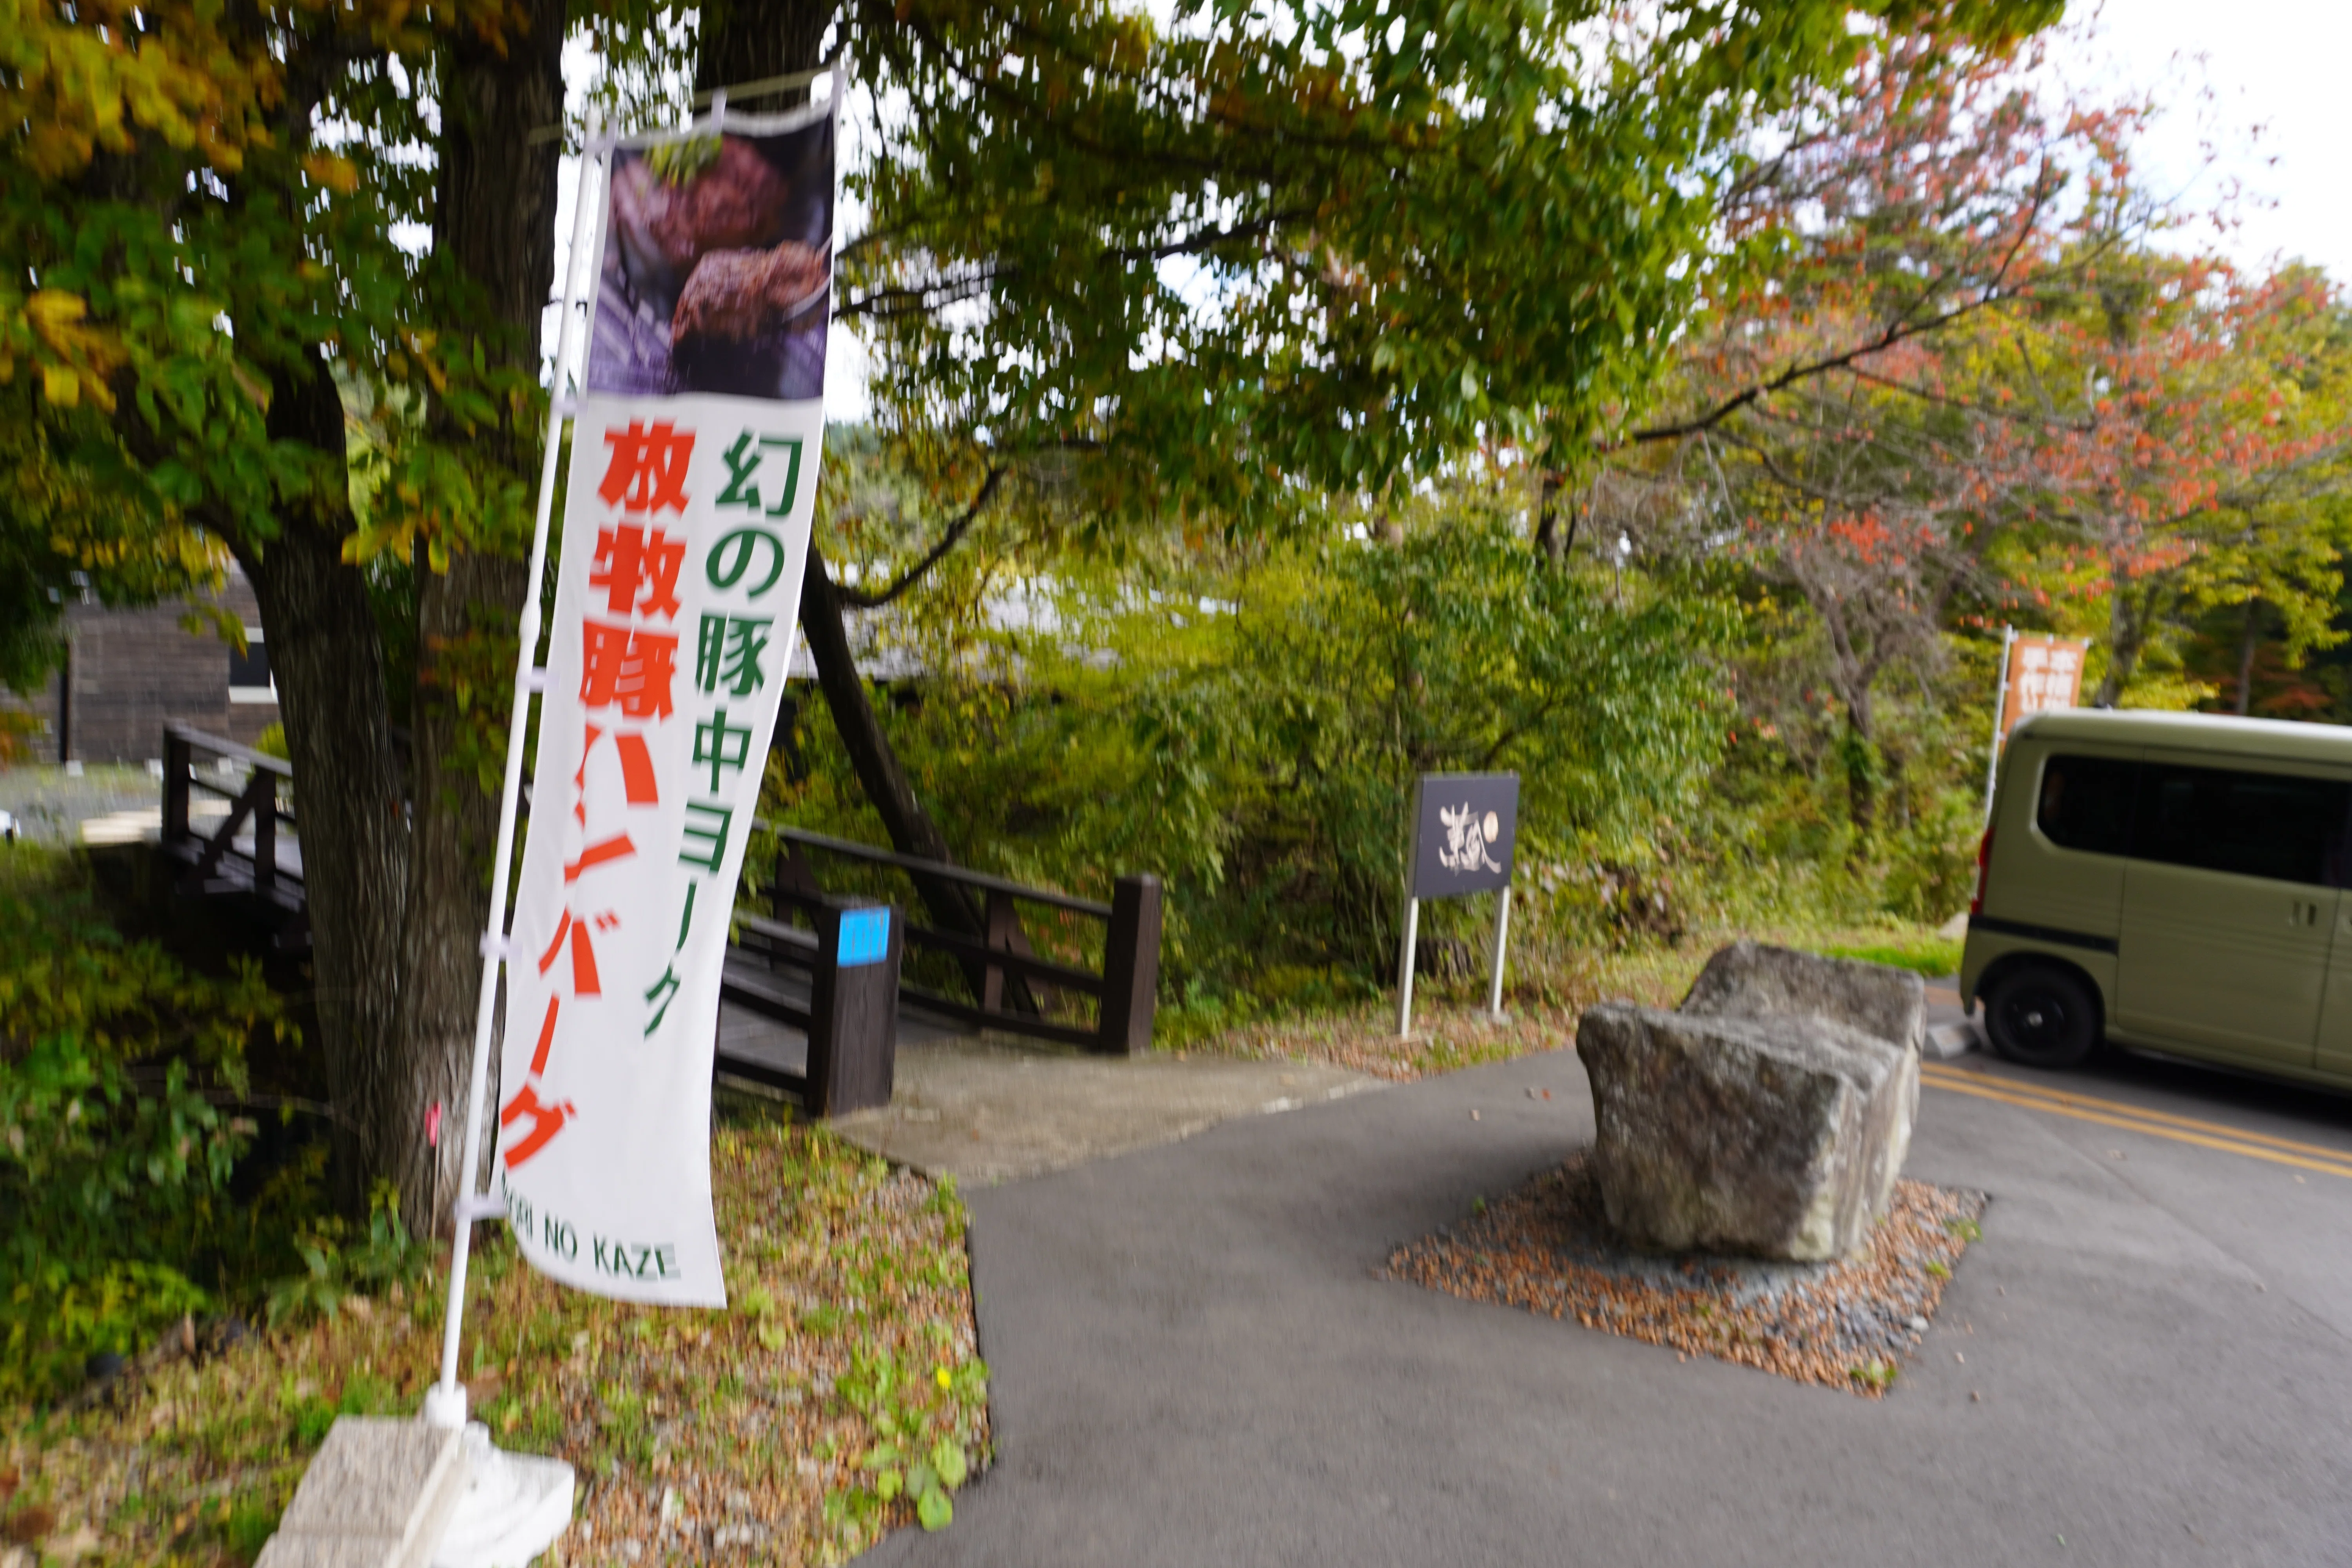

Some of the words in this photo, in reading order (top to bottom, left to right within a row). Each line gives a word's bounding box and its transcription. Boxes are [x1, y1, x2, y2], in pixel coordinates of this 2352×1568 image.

[500, 417, 696, 1170] 放牧豚ハンバーグ
[545, 1211, 577, 1263] NO
[593, 1232, 681, 1281] KAZE
